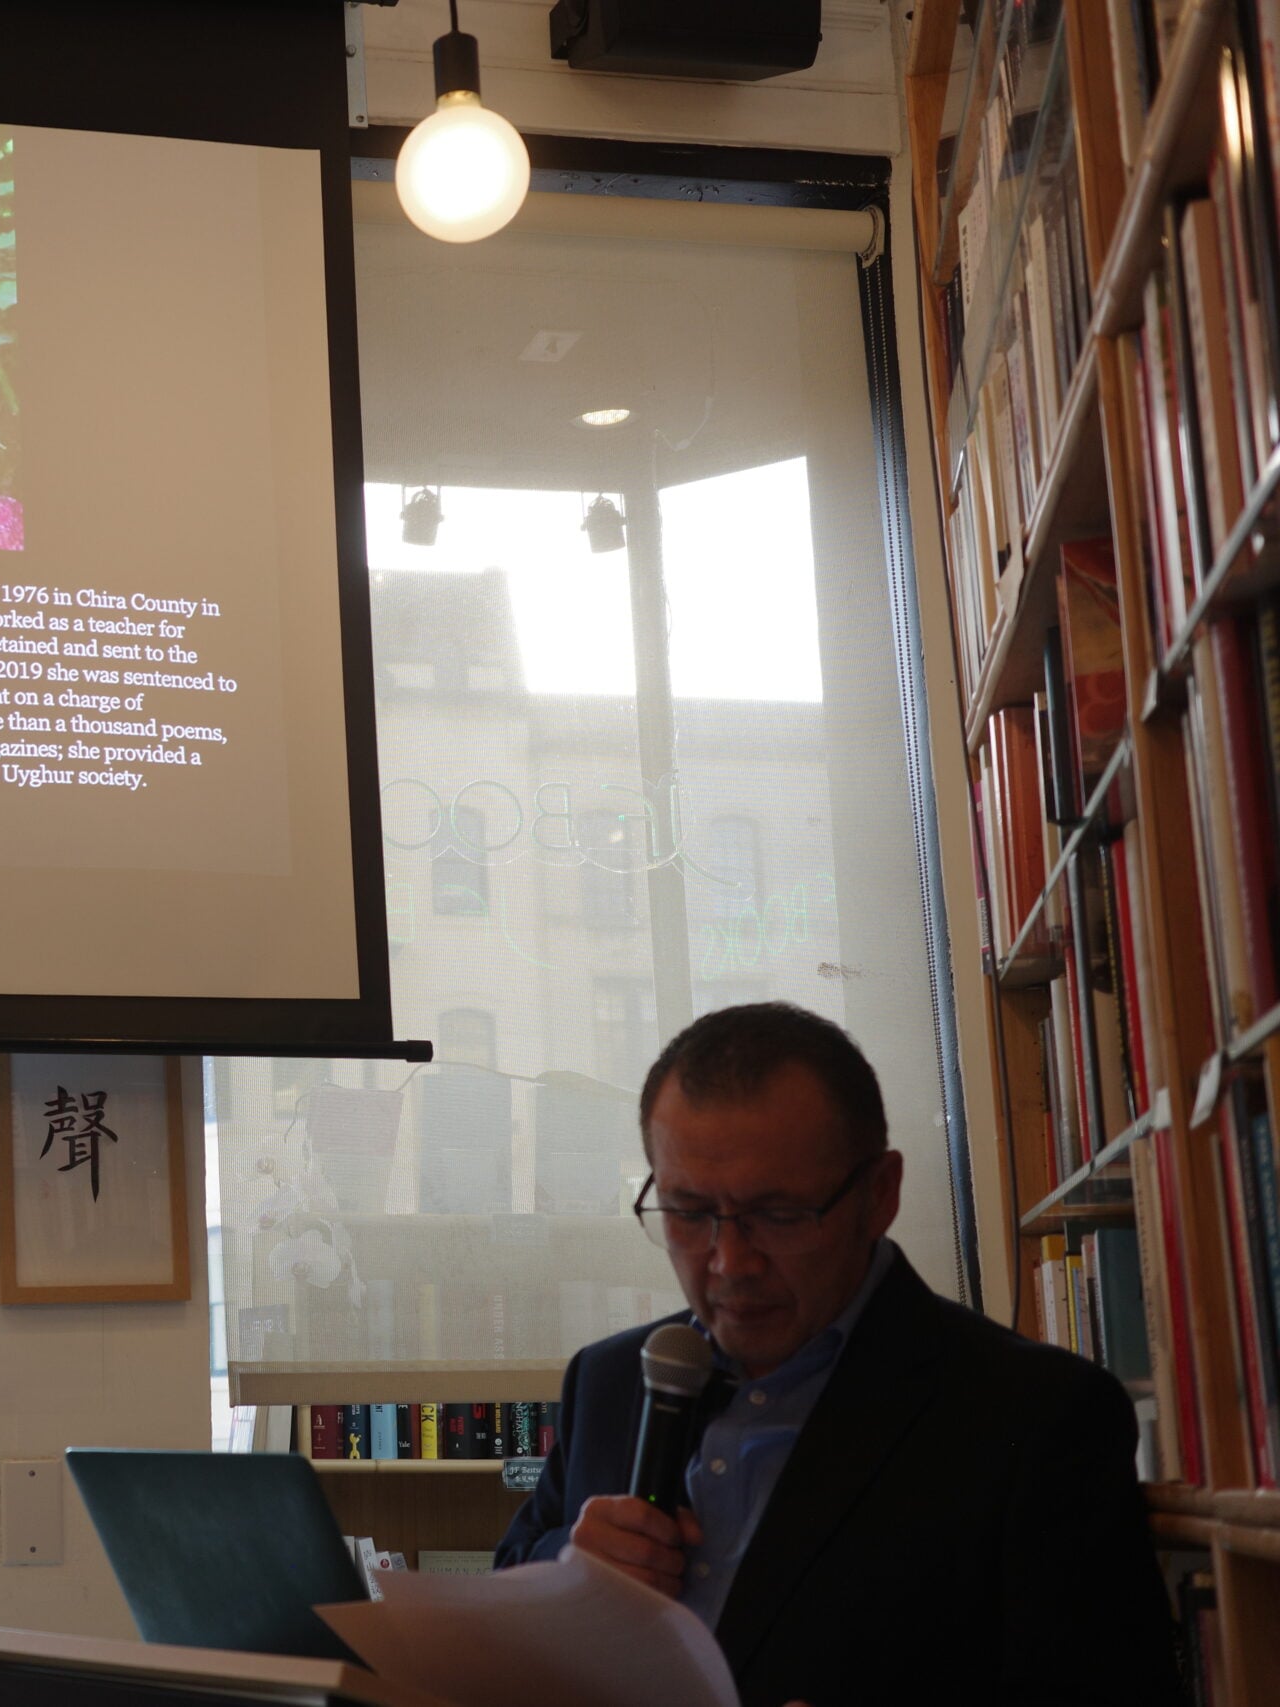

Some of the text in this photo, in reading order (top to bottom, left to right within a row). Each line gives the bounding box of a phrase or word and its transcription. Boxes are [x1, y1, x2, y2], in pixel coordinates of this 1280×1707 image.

[1, 584, 50, 605] 1976
[52, 587, 73, 606] in
[76, 588, 128, 610] Chira
[130, 592, 199, 619] County
[201, 597, 221, 617] in
[48, 617, 70, 631] as
[72, 618, 85, 632] a
[87, 616, 156, 637] teacher
[158, 619, 186, 639] for
[63, 638, 100, 658] and
[102, 644, 142, 660] sent
[144, 644, 165, 662] to
[167, 644, 198, 665] the
[46, 662, 79, 682] she
[81, 669, 120, 684] was
[123, 670, 215, 691] sentenced
[217, 675, 238, 693] to
[7, 711, 52, 732] than
[54, 718, 68, 733] a
[69, 713, 159, 737] thousand
[160, 724, 228, 745] poems,
[40, 1085, 119, 1203] 聲
